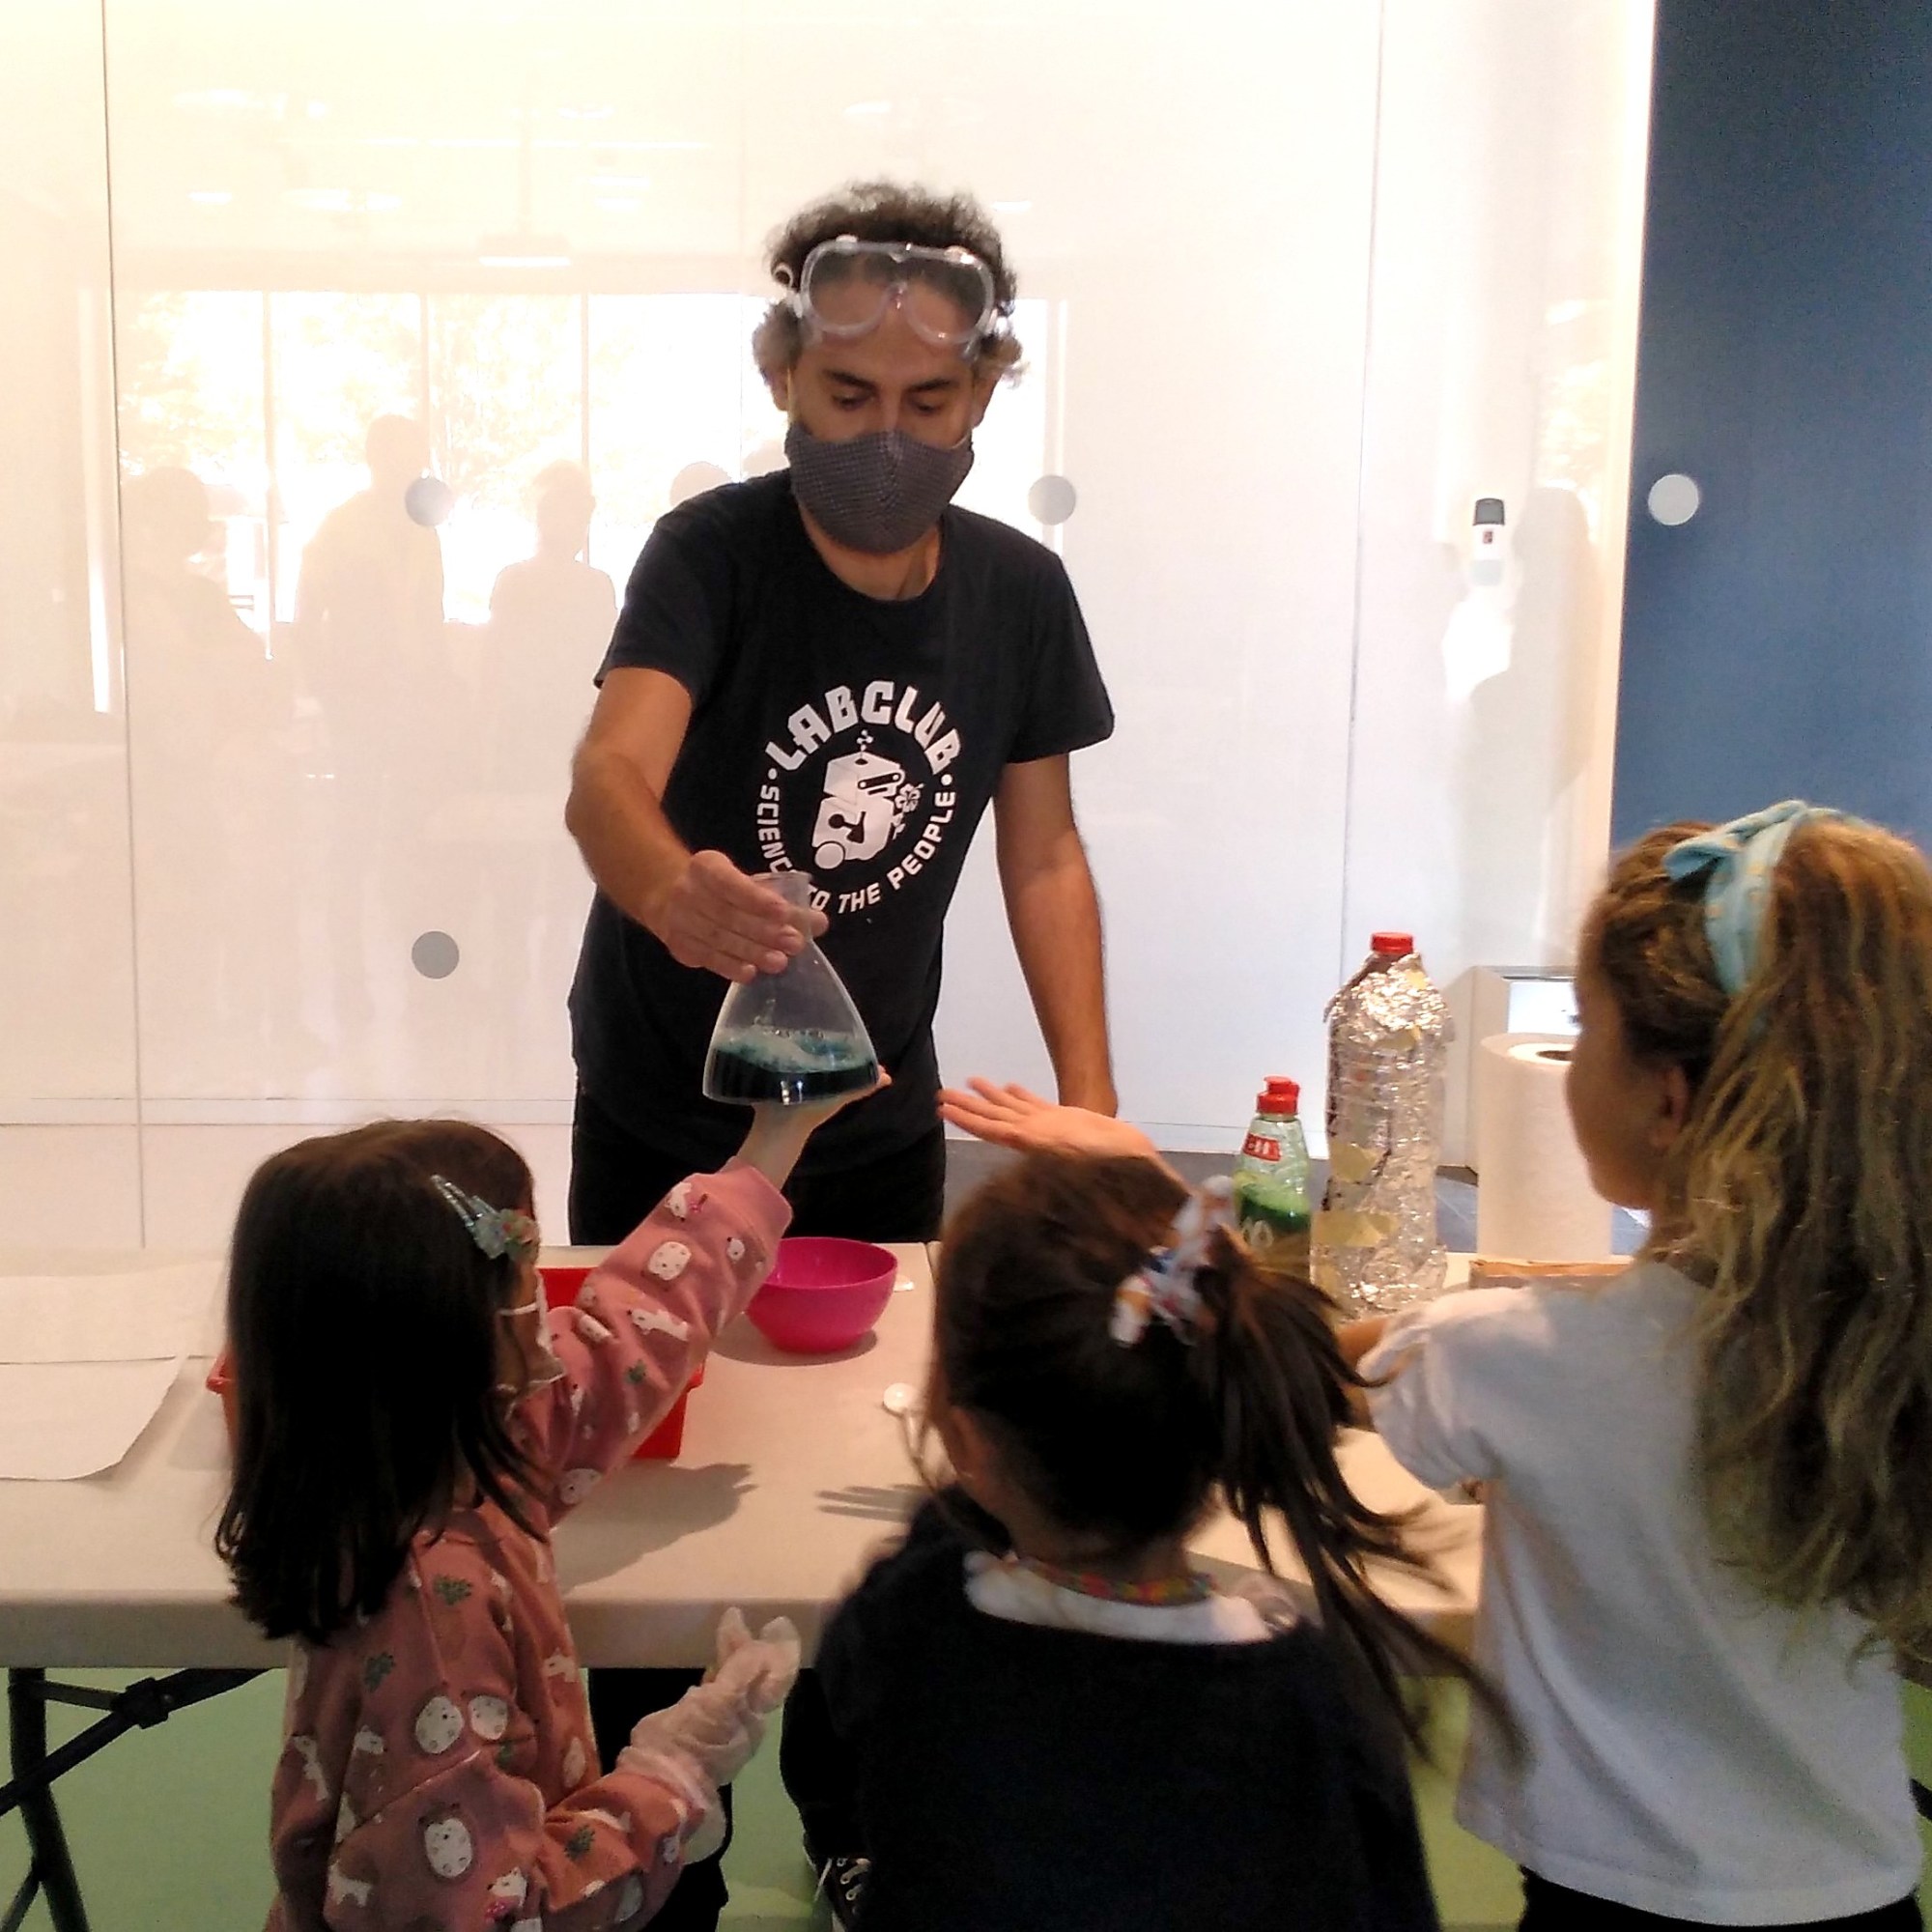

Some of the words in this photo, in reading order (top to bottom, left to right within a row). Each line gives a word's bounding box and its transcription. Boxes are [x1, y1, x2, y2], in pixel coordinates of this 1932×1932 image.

[765, 680, 961, 775] LABCLUB
[756, 784, 797, 874] SCIENC
[838, 882, 881, 914] THE
[887, 791, 955, 891] PEOPLE
